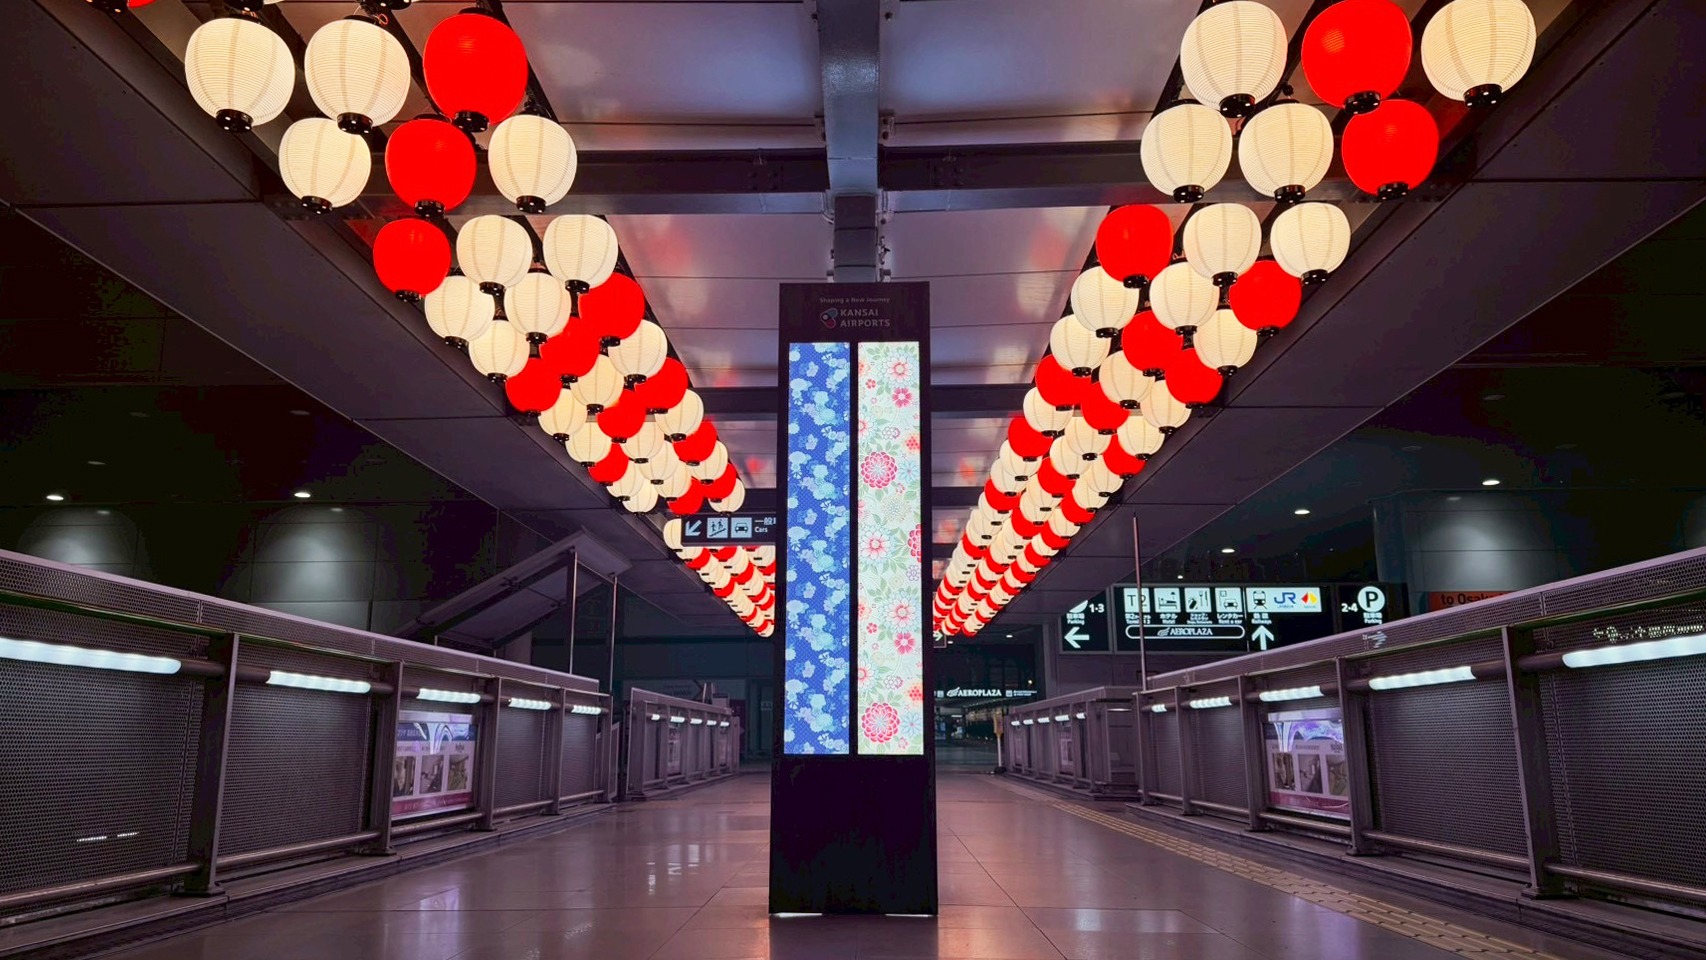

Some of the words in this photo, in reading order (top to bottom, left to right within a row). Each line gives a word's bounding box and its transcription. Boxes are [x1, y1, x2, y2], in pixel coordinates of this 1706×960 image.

[840, 308, 879, 317] KANSAI
[840, 319, 891, 328] AIRPORTS
[1274, 592, 1296, 604] JR
[1365, 591, 1379, 608] P
[1441, 593, 1454, 605] to
[1170, 628, 1213, 636] AEROPLAZA
[958, 689, 1002, 697] AEROPLAZA
